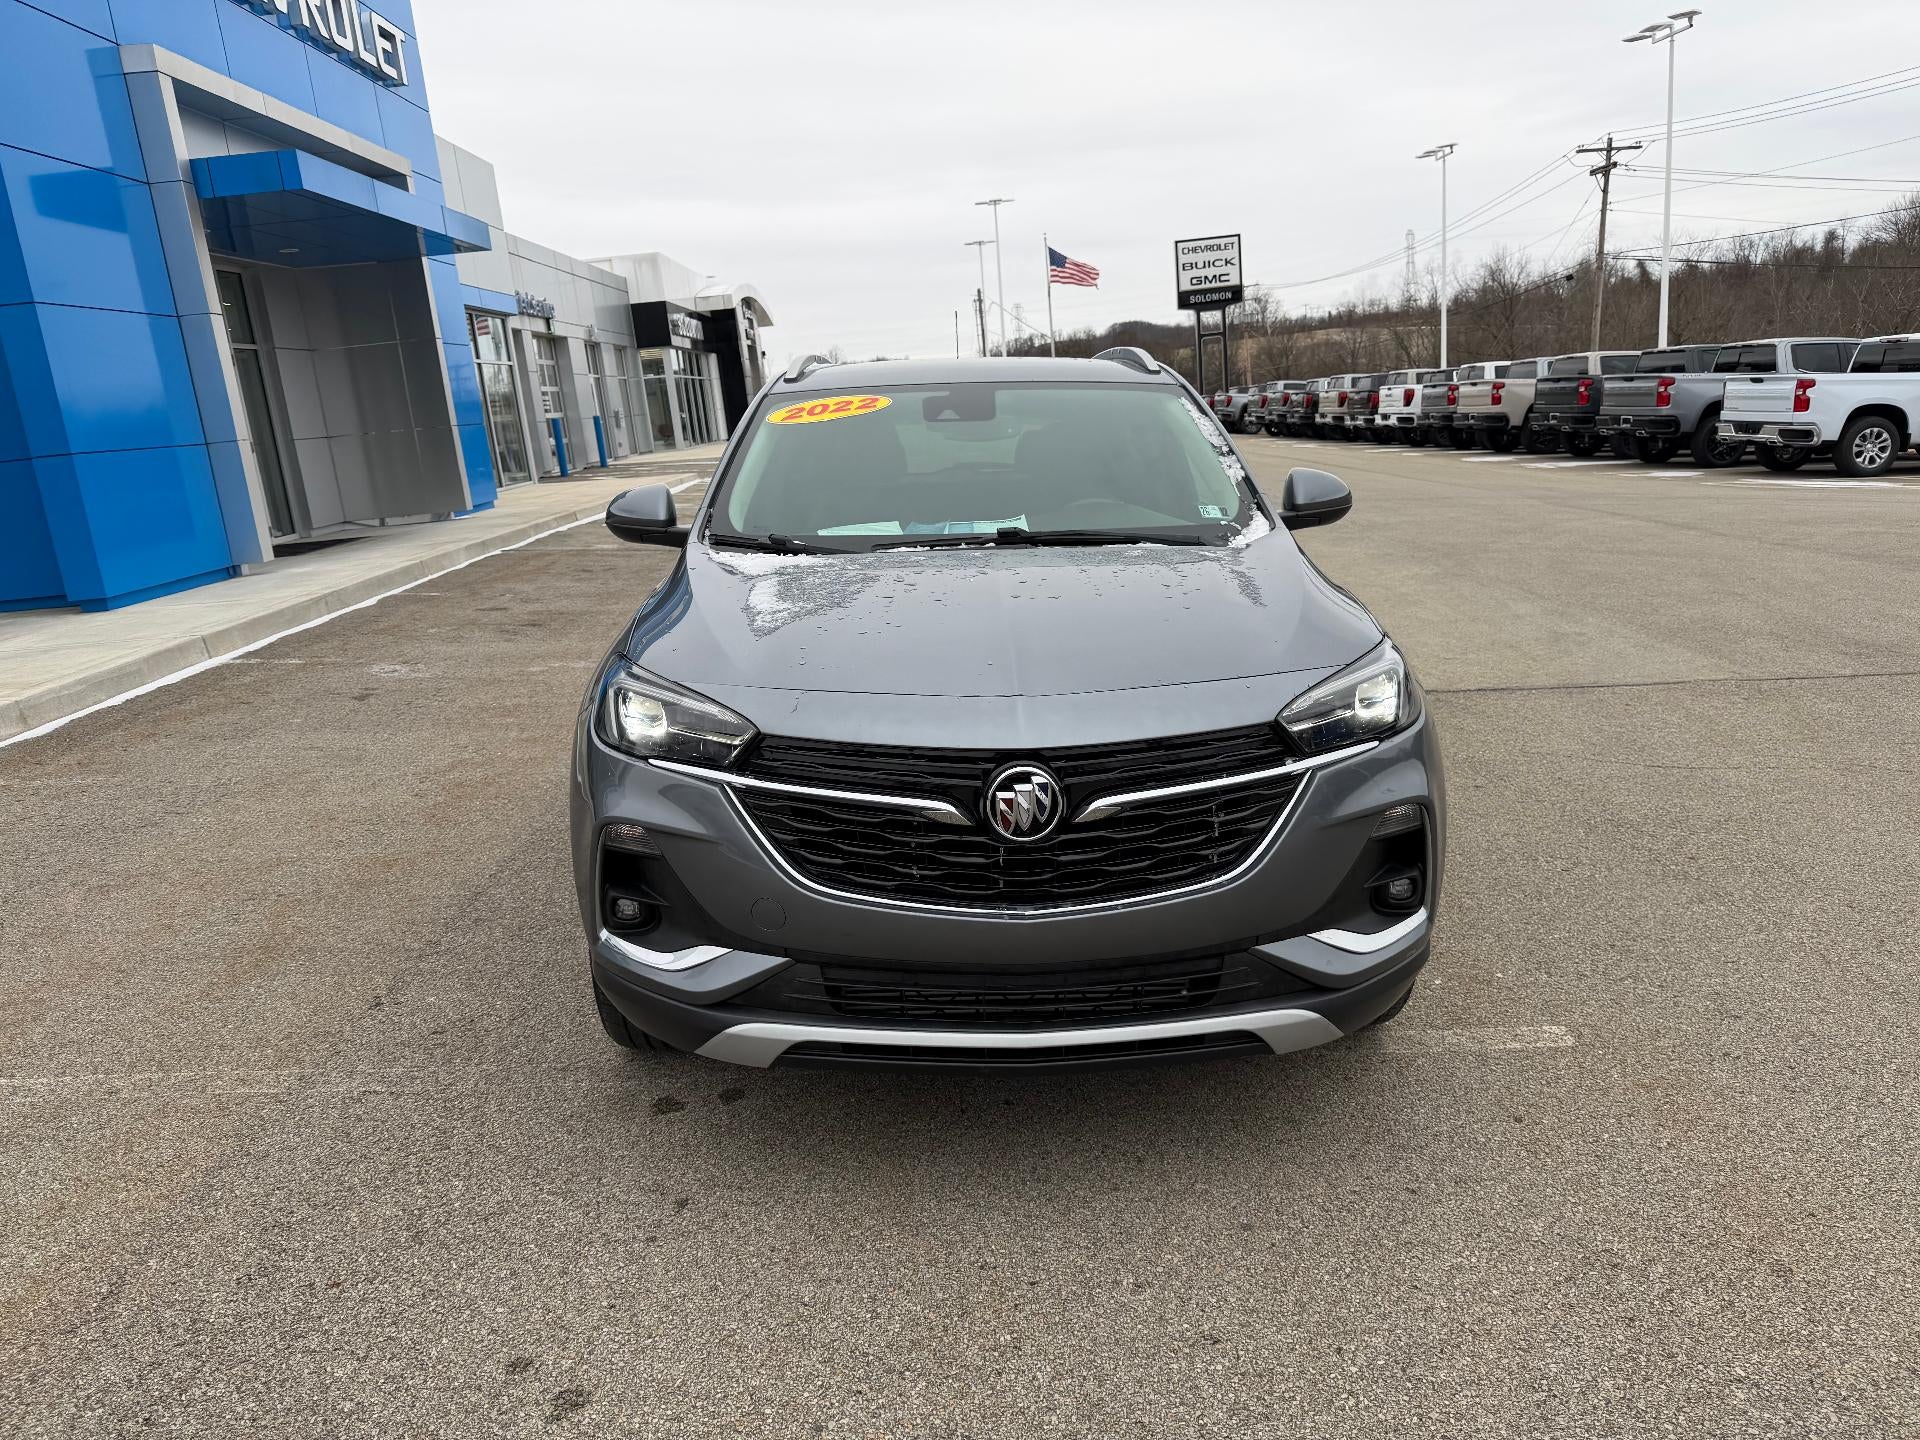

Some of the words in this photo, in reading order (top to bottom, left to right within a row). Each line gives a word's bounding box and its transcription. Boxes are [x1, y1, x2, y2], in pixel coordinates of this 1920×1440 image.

[1181, 241, 1235, 255] CHEVROLET
[1181, 256, 1237, 271] BUICK
[1190, 273, 1231, 286] GMC
[1189, 291, 1233, 304] SOLOMON
[780, 397, 881, 422] 2022
